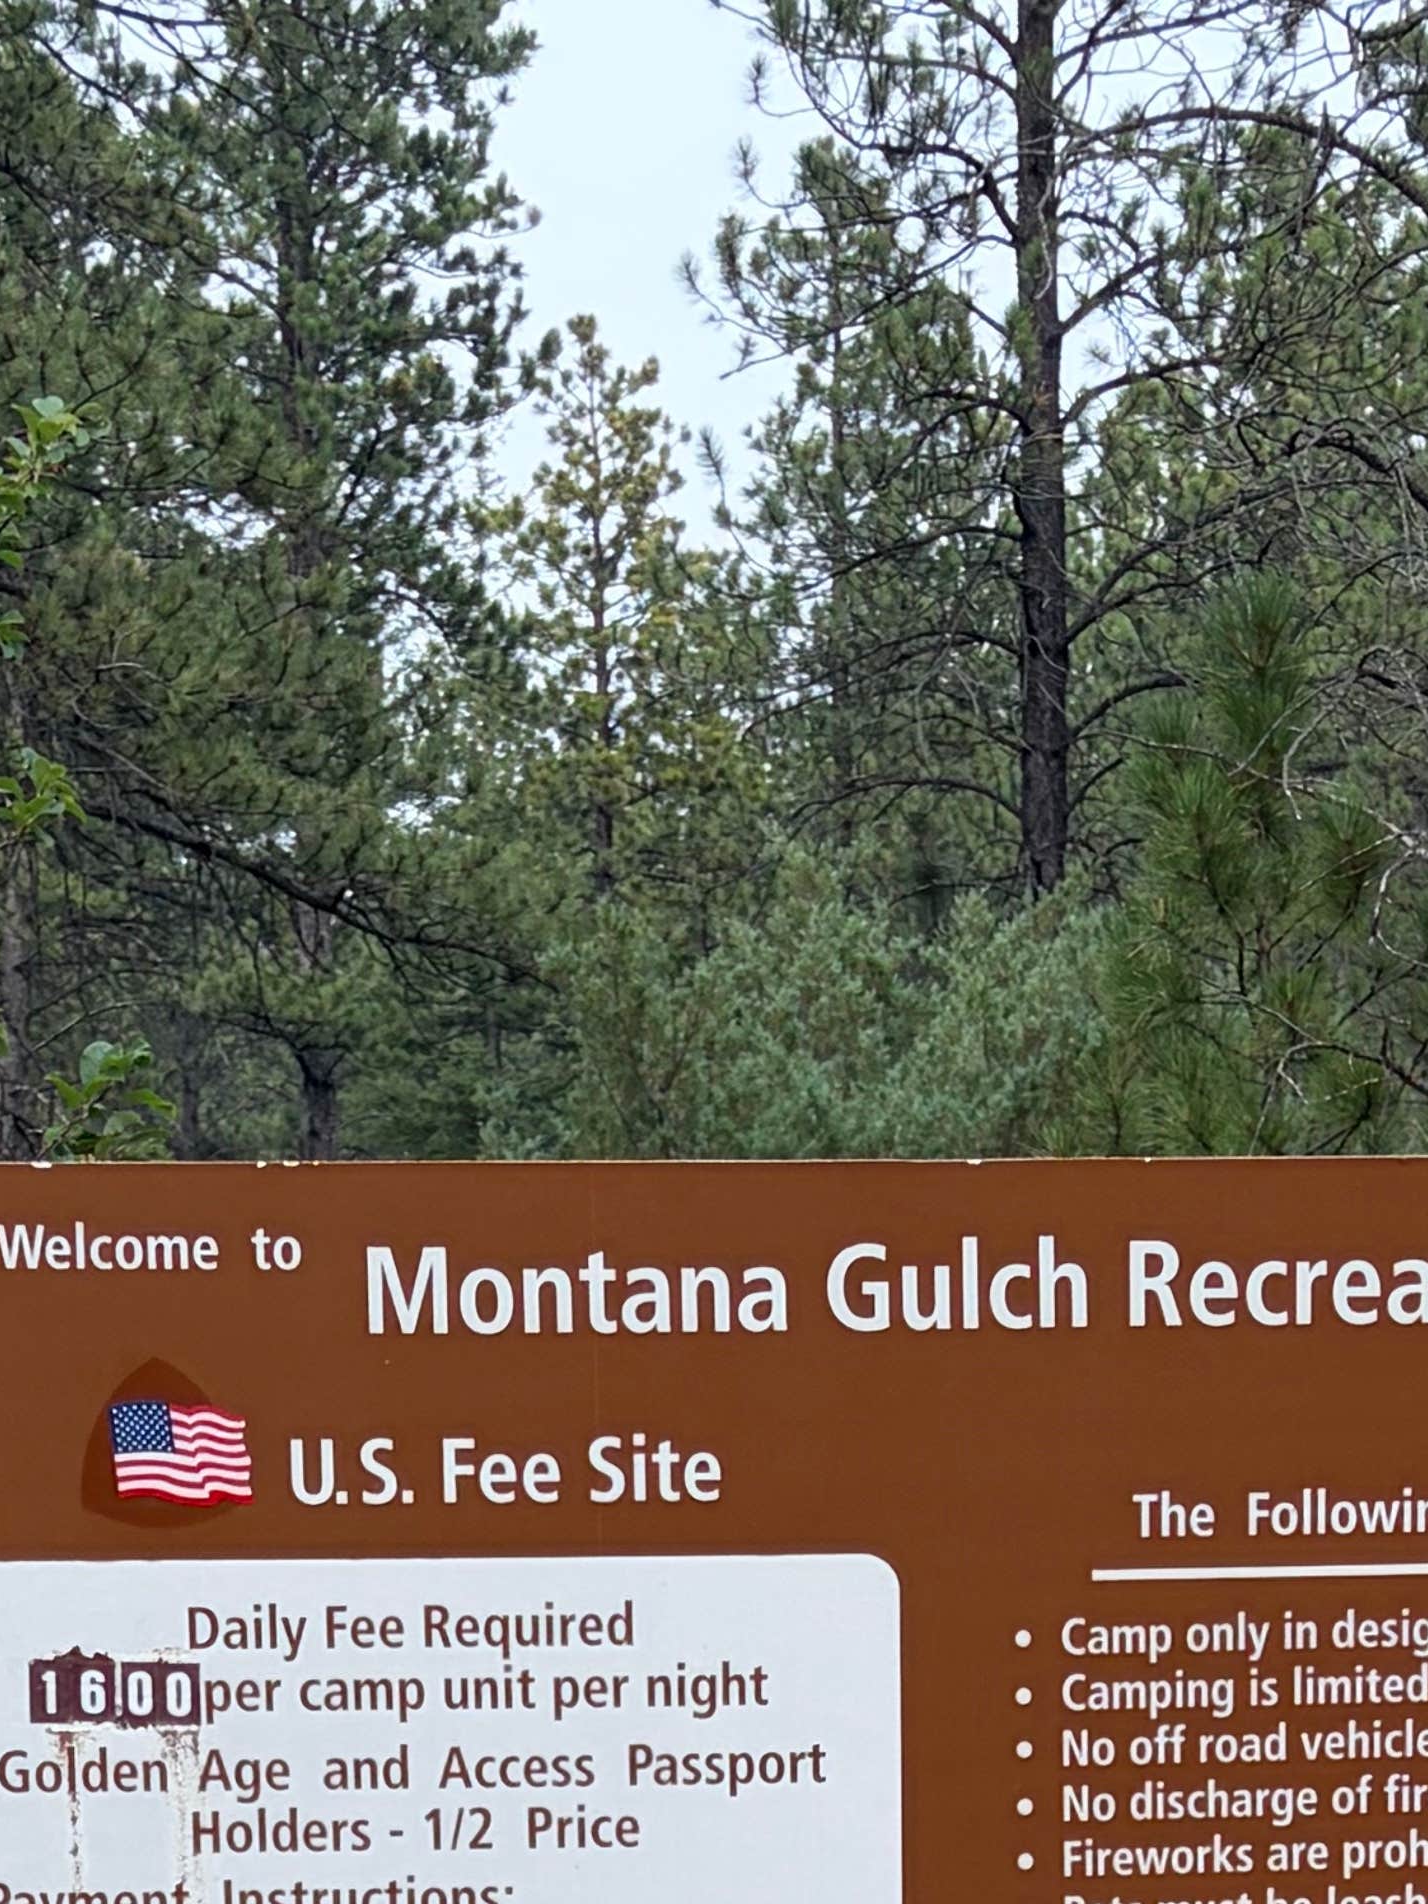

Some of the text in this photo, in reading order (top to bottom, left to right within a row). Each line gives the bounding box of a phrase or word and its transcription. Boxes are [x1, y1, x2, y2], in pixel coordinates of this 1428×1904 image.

[250, 1228, 302, 1271] to
[366, 1246, 788, 1335] Montana
[826, 1235, 1088, 1332] Gulch
[290, 1432, 722, 1506] U.S. Fee Site
[1132, 1490, 1215, 1538] The
[187, 1599, 634, 1662] Daily Fee Required
[1061, 1617, 1172, 1664] Camp
[1186, 1610, 1270, 1662] only
[1284, 1610, 1318, 1650] in
[203, 1676, 283, 1727] per
[299, 1677, 425, 1723] camp
[443, 1664, 536, 1710] unit
[553, 1675, 630, 1721] per
[647, 1660, 769, 1720] night
[1062, 1669, 1234, 1720] Camping
[1250, 1667, 1279, 1707] is
[1293, 1661, 1428, 1706] limited
[1062, 1728, 1116, 1767] No
[1129, 1723, 1187, 1766] off
[1199, 1721, 1287, 1764] road
[198, 1748, 290, 1804] Age
[323, 1743, 409, 1791] and
[438, 1746, 595, 1789] Access
[628, 1743, 827, 1797] Passport
[1062, 1784, 1116, 1822] No
[1130, 1778, 1318, 1827] discharge
[1331, 1773, 1373, 1815] of
[191, 1807, 371, 1857] Holders
[424, 1806, 493, 1851] 1/2
[527, 1804, 640, 1849] Price
[1063, 1833, 1254, 1877] Fireworks
[1266, 1842, 1329, 1872] are
